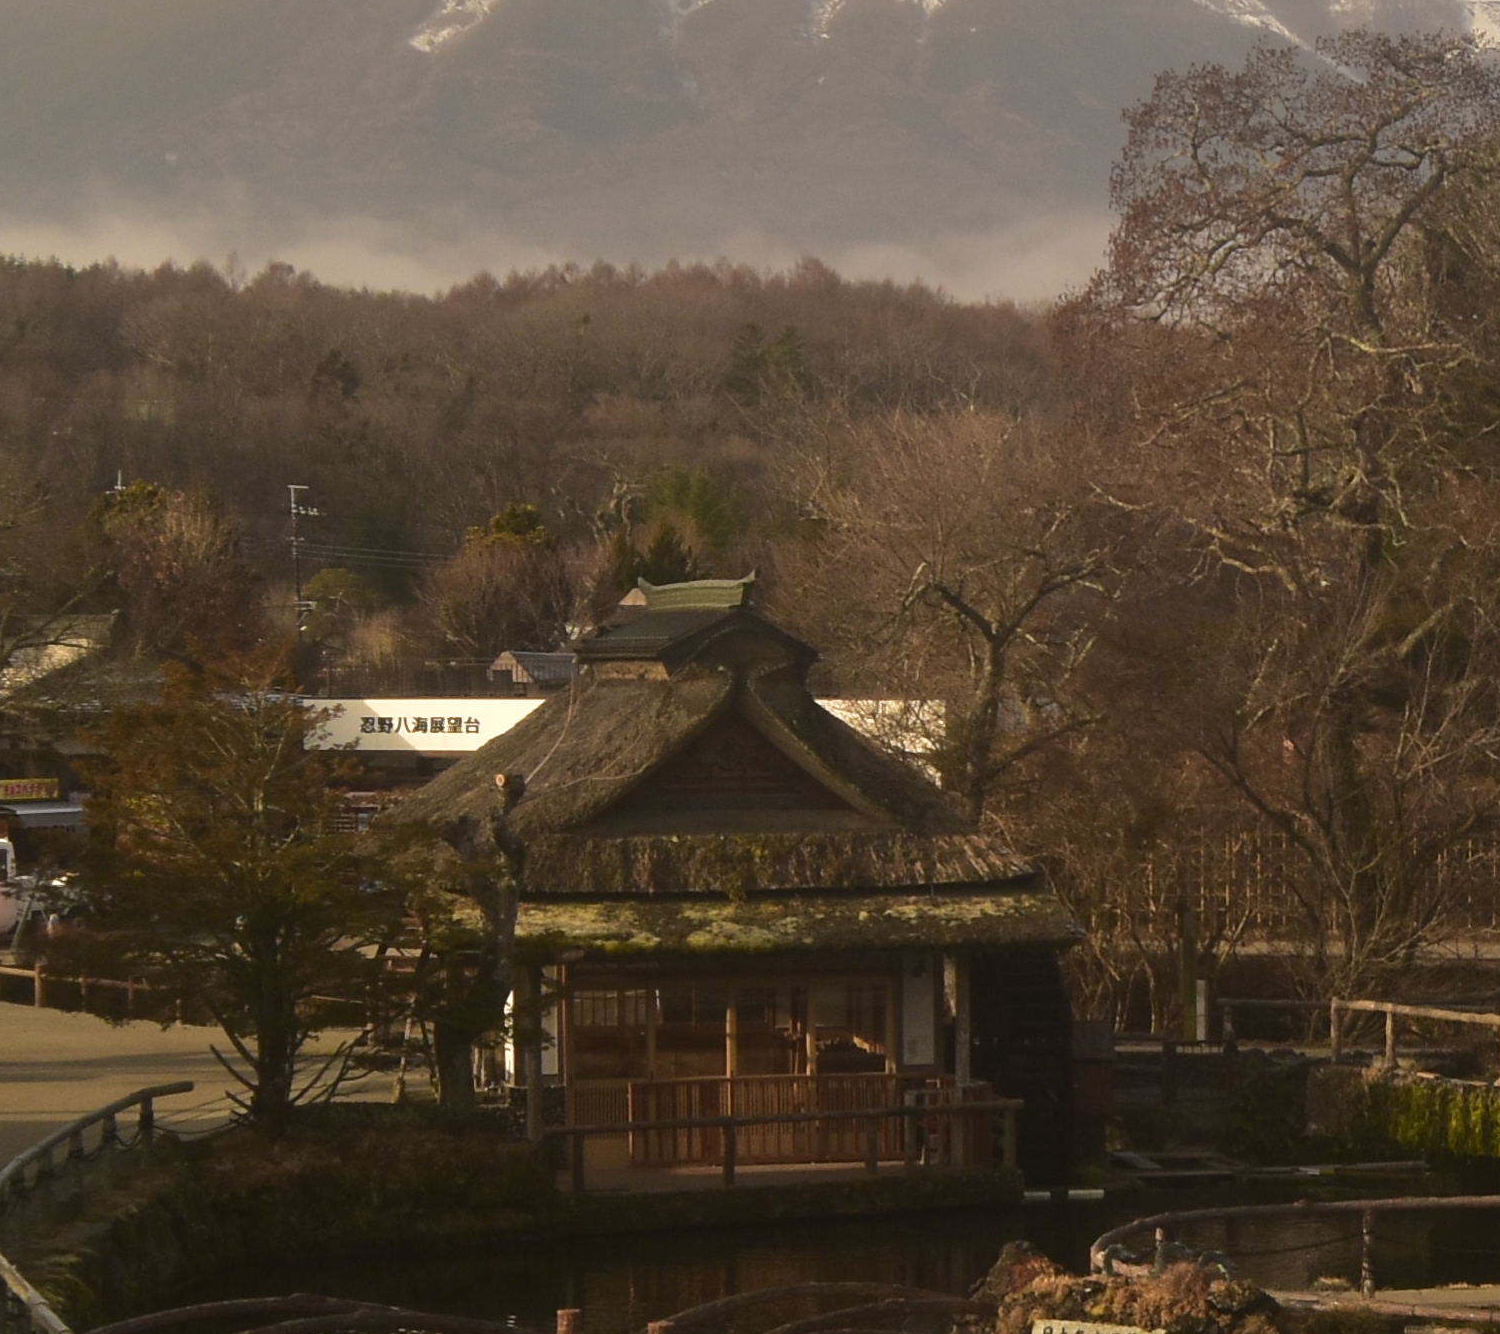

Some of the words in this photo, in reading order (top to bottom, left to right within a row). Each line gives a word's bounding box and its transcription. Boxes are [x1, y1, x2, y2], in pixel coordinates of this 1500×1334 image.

[360, 716, 481, 734] 忍野八海展望台
